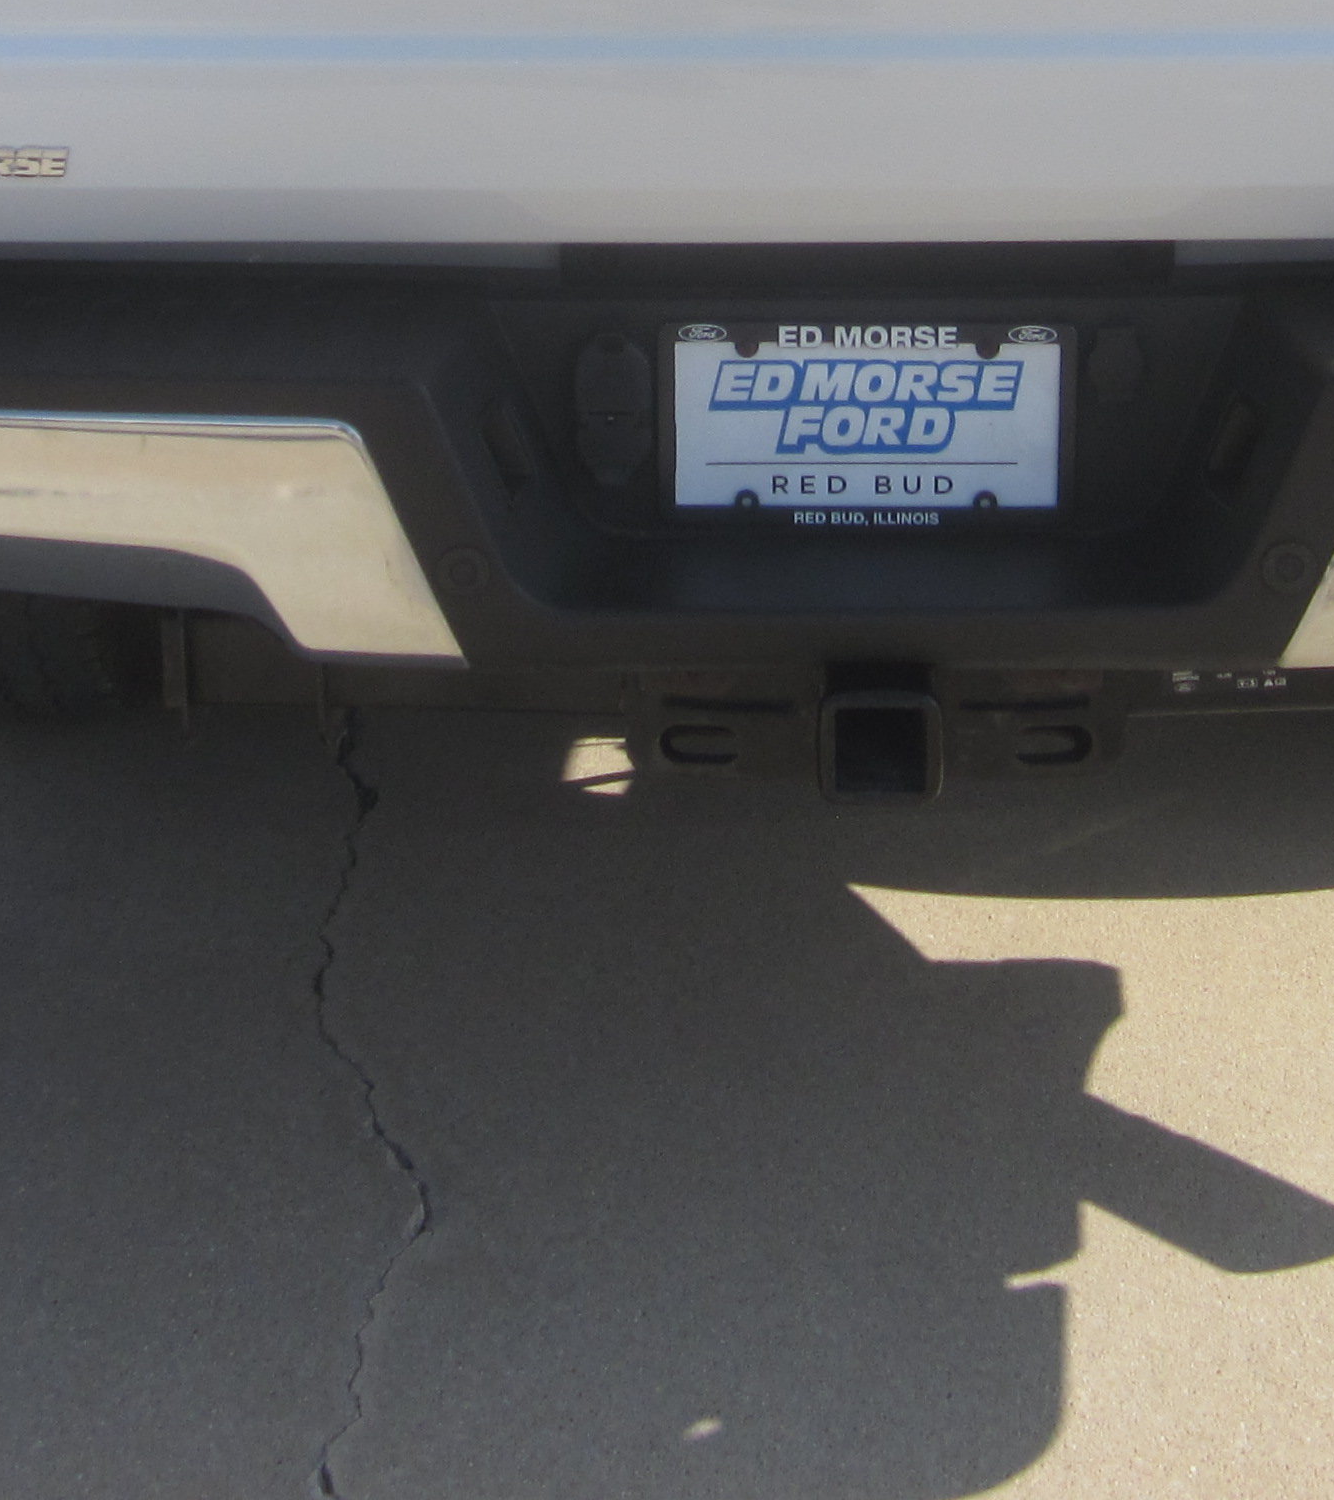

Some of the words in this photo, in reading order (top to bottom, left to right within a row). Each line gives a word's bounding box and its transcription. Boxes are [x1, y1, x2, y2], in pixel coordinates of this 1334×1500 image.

[777, 325, 823, 349] ED
[834, 325, 958, 350] MORSE
[711, 361, 799, 405] ED
[799, 361, 1021, 406] MORSE
[778, 405, 954, 451] FORD
[772, 475, 848, 495] RED
[874, 475, 954, 495] BUD
[793, 512, 826, 525] RED
[830, 512, 868, 527] BUD,
[872, 512, 939, 526] ILLINOIS
